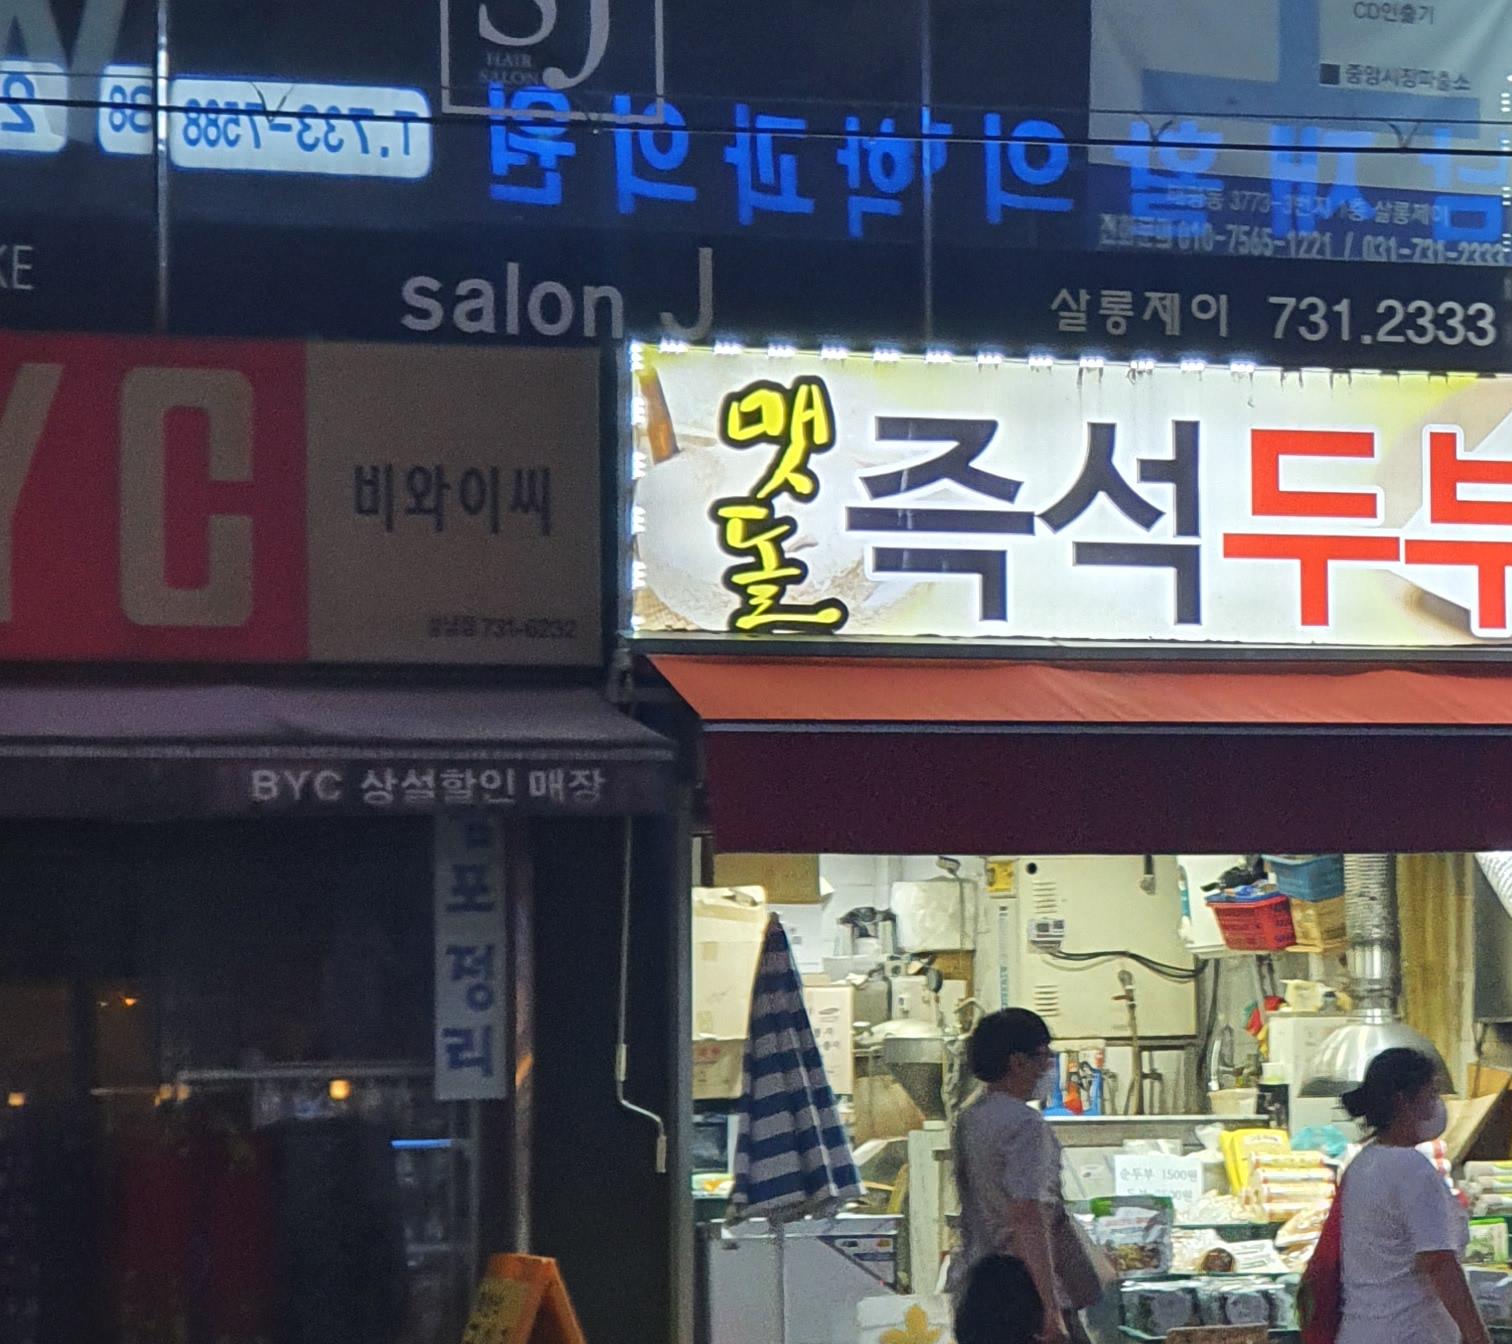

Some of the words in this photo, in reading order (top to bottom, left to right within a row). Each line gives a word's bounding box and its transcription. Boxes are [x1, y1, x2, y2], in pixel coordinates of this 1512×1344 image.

[402, 261, 625, 339] salon
[660, 247, 714, 341] J
[1049, 287, 1229, 337] 살롱제이
[1268, 295, 1497, 346] 731.2333
[352, 462, 552, 536] 비와이씨
[250, 768, 344, 802] BYC
[360, 765, 517, 806] 상설할인
[528, 766, 606, 806] 매장
